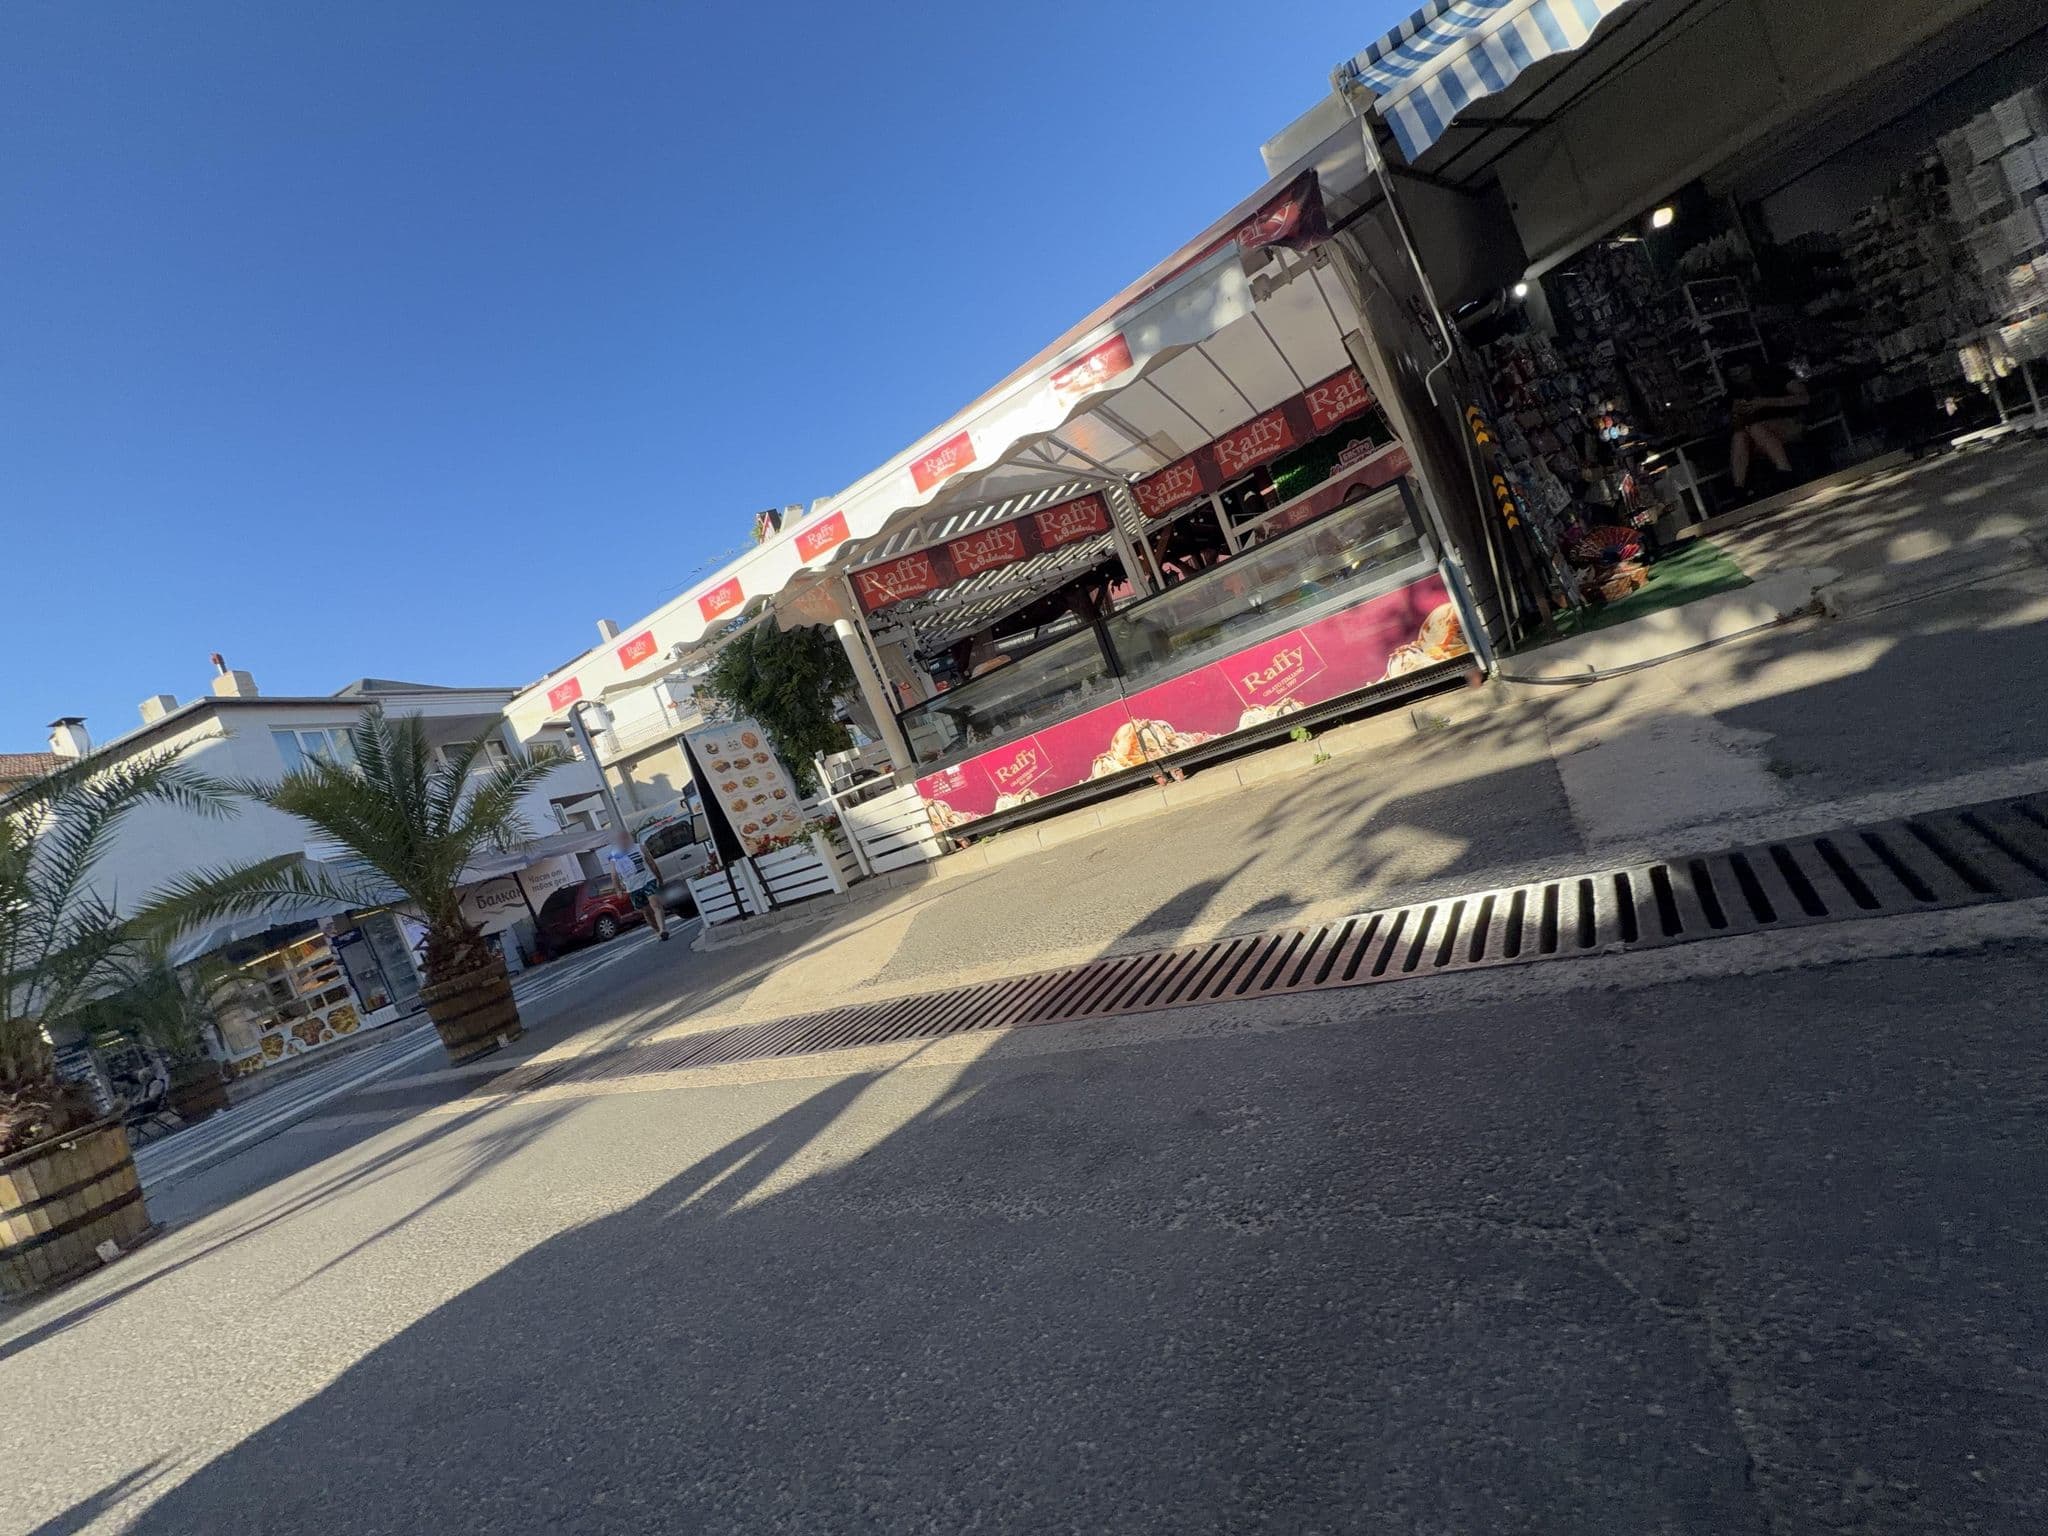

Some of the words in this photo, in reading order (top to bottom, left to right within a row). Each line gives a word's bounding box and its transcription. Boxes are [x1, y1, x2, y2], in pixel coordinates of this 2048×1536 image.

[924, 446, 957, 474] Raffy
[1214, 416, 1285, 466] Raffy
[1134, 464, 1197, 505] Raffy
[807, 522, 836, 546] Raffy
[1035, 499, 1098, 535] Raffy
[949, 526, 1018, 564] Raffy
[855, 556, 930, 595] Raffy
[1239, 645, 1303, 695] Raffy
[995, 747, 1038, 783] Raffy
